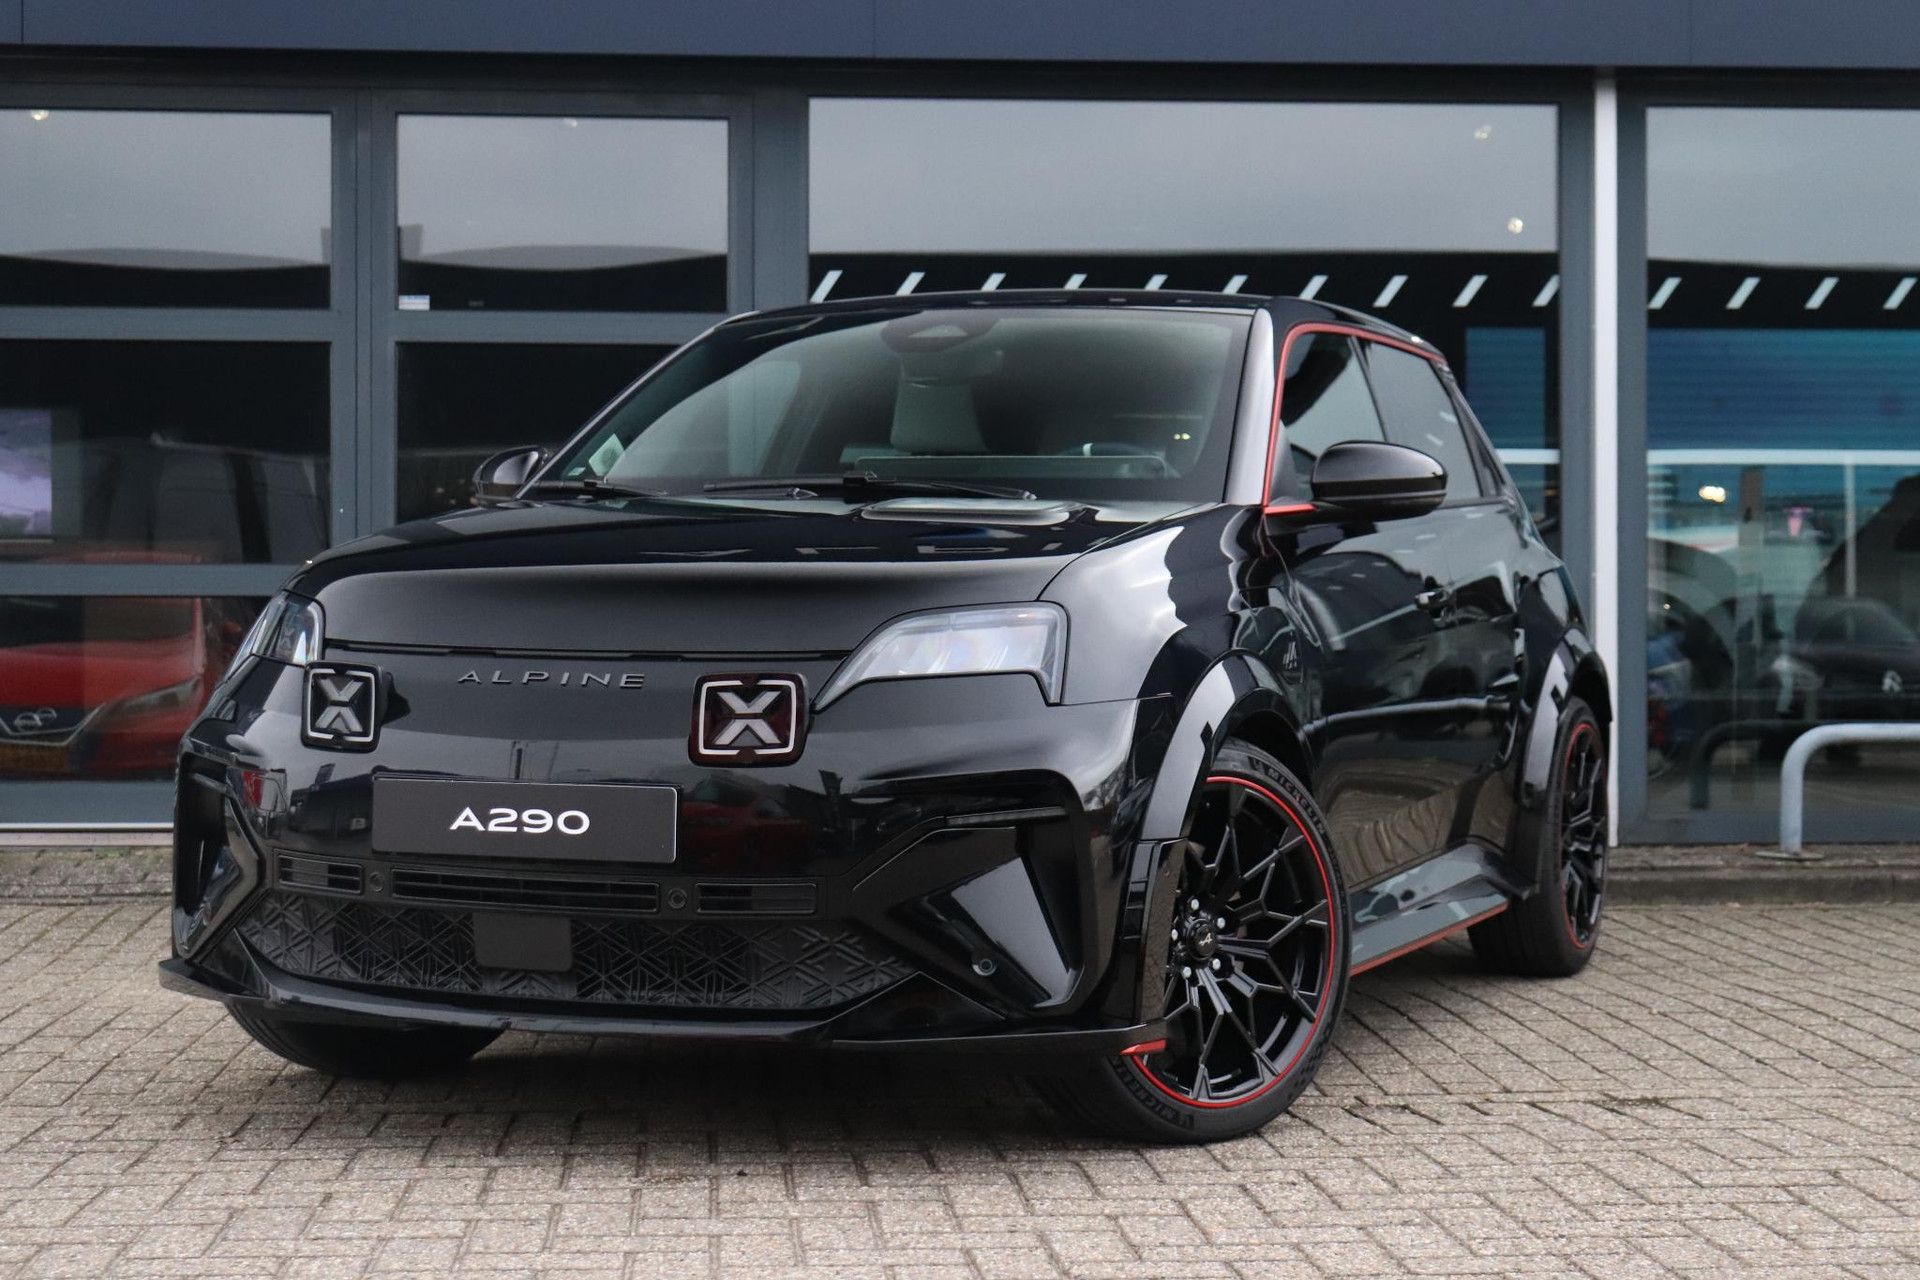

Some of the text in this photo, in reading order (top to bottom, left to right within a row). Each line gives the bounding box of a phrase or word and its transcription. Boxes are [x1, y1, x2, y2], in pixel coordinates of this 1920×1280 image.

[457, 670, 646, 690] ALPINE
[1267, 766, 1325, 835] MICHELIN
[449, 806, 591, 835] A290
